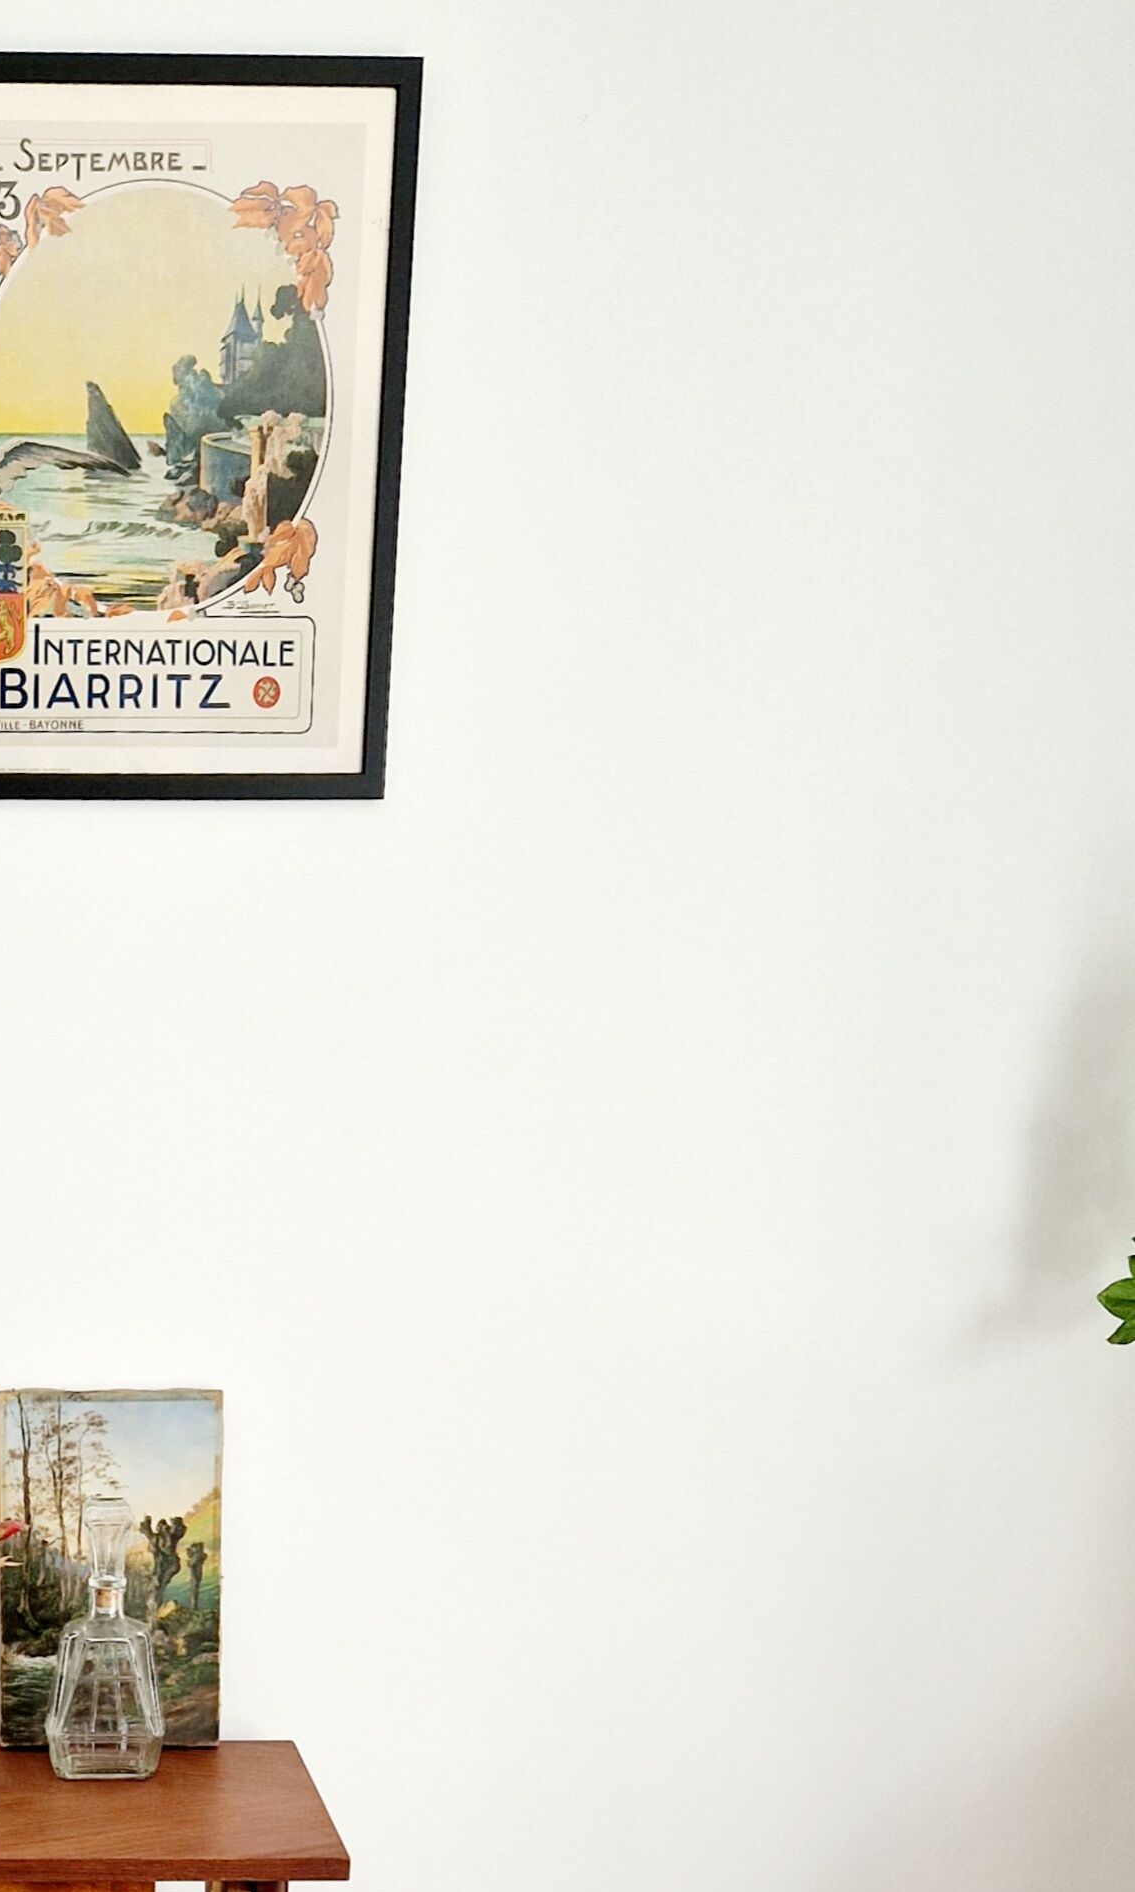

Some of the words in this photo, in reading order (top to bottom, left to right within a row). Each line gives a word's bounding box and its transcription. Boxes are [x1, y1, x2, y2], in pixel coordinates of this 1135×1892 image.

[14, 138, 182, 181] SEPTEMBRE
[33, 624, 294, 666] INTERNATIONALE
[0, 667, 231, 709] BIARRITZ
[29, 720, 85, 730] BAYONNE
